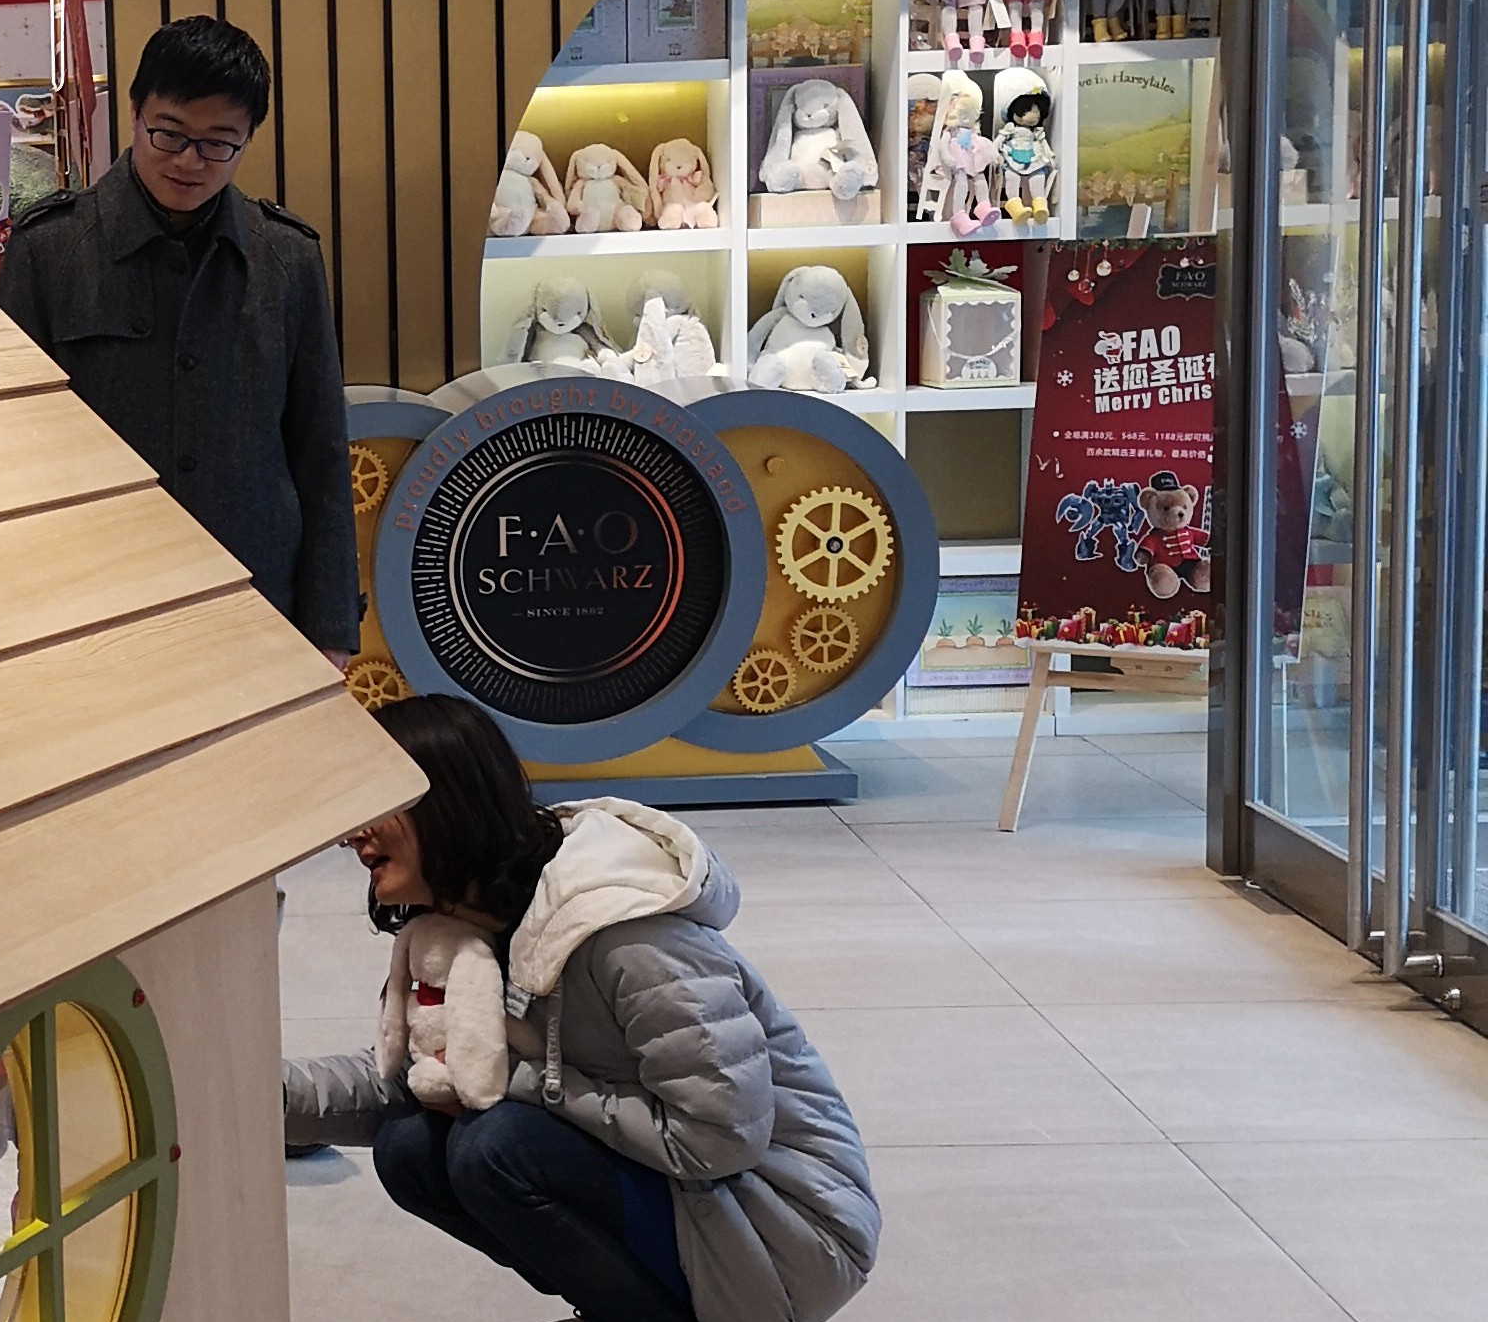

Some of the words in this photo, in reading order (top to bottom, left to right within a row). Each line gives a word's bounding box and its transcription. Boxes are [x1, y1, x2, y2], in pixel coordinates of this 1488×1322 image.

[1122, 325, 1181, 362] FAO
[1095, 391, 1152, 414] Merry
[395, 428, 472, 531] proudly
[475, 384, 597, 430] brought
[609, 386, 645, 420] by
[648, 405, 748, 515] kidsland
[478, 563, 654, 595] SCHWARZ
[527, 607, 571, 618] SINCE
